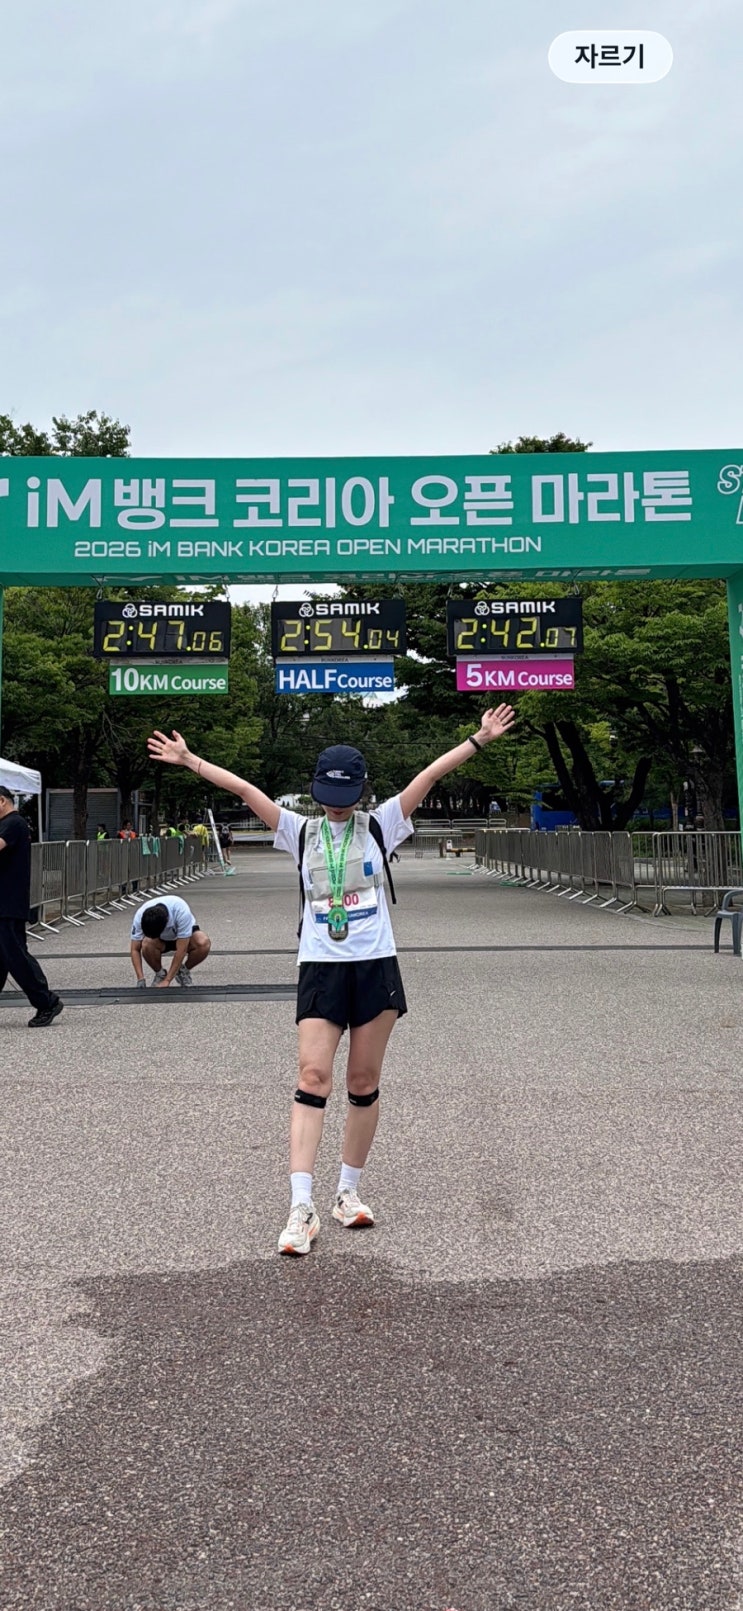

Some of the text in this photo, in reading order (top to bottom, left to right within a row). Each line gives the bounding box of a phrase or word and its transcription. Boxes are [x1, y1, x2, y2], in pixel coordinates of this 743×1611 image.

[717, 464, 743, 495] S
[26, 476, 102, 528] iM
[113, 478, 220, 530] 뱅크
[233, 476, 395, 529] 코리아
[410, 475, 514, 526] 오픈
[531, 470, 693, 525] 마라톤
[74, 536, 542, 558] 2026 iM BANK KOREA OPEN MARATHON
[139, 604, 205, 617] SAMIK
[315, 602, 380, 615] SAMIK
[491, 601, 556, 614] SAMIK
[111, 667, 227, 692] 10KM Course
[279, 668, 393, 690] HALF Course
[466, 663, 573, 687] 5KM Course
[328, 893, 359, 908] 800
